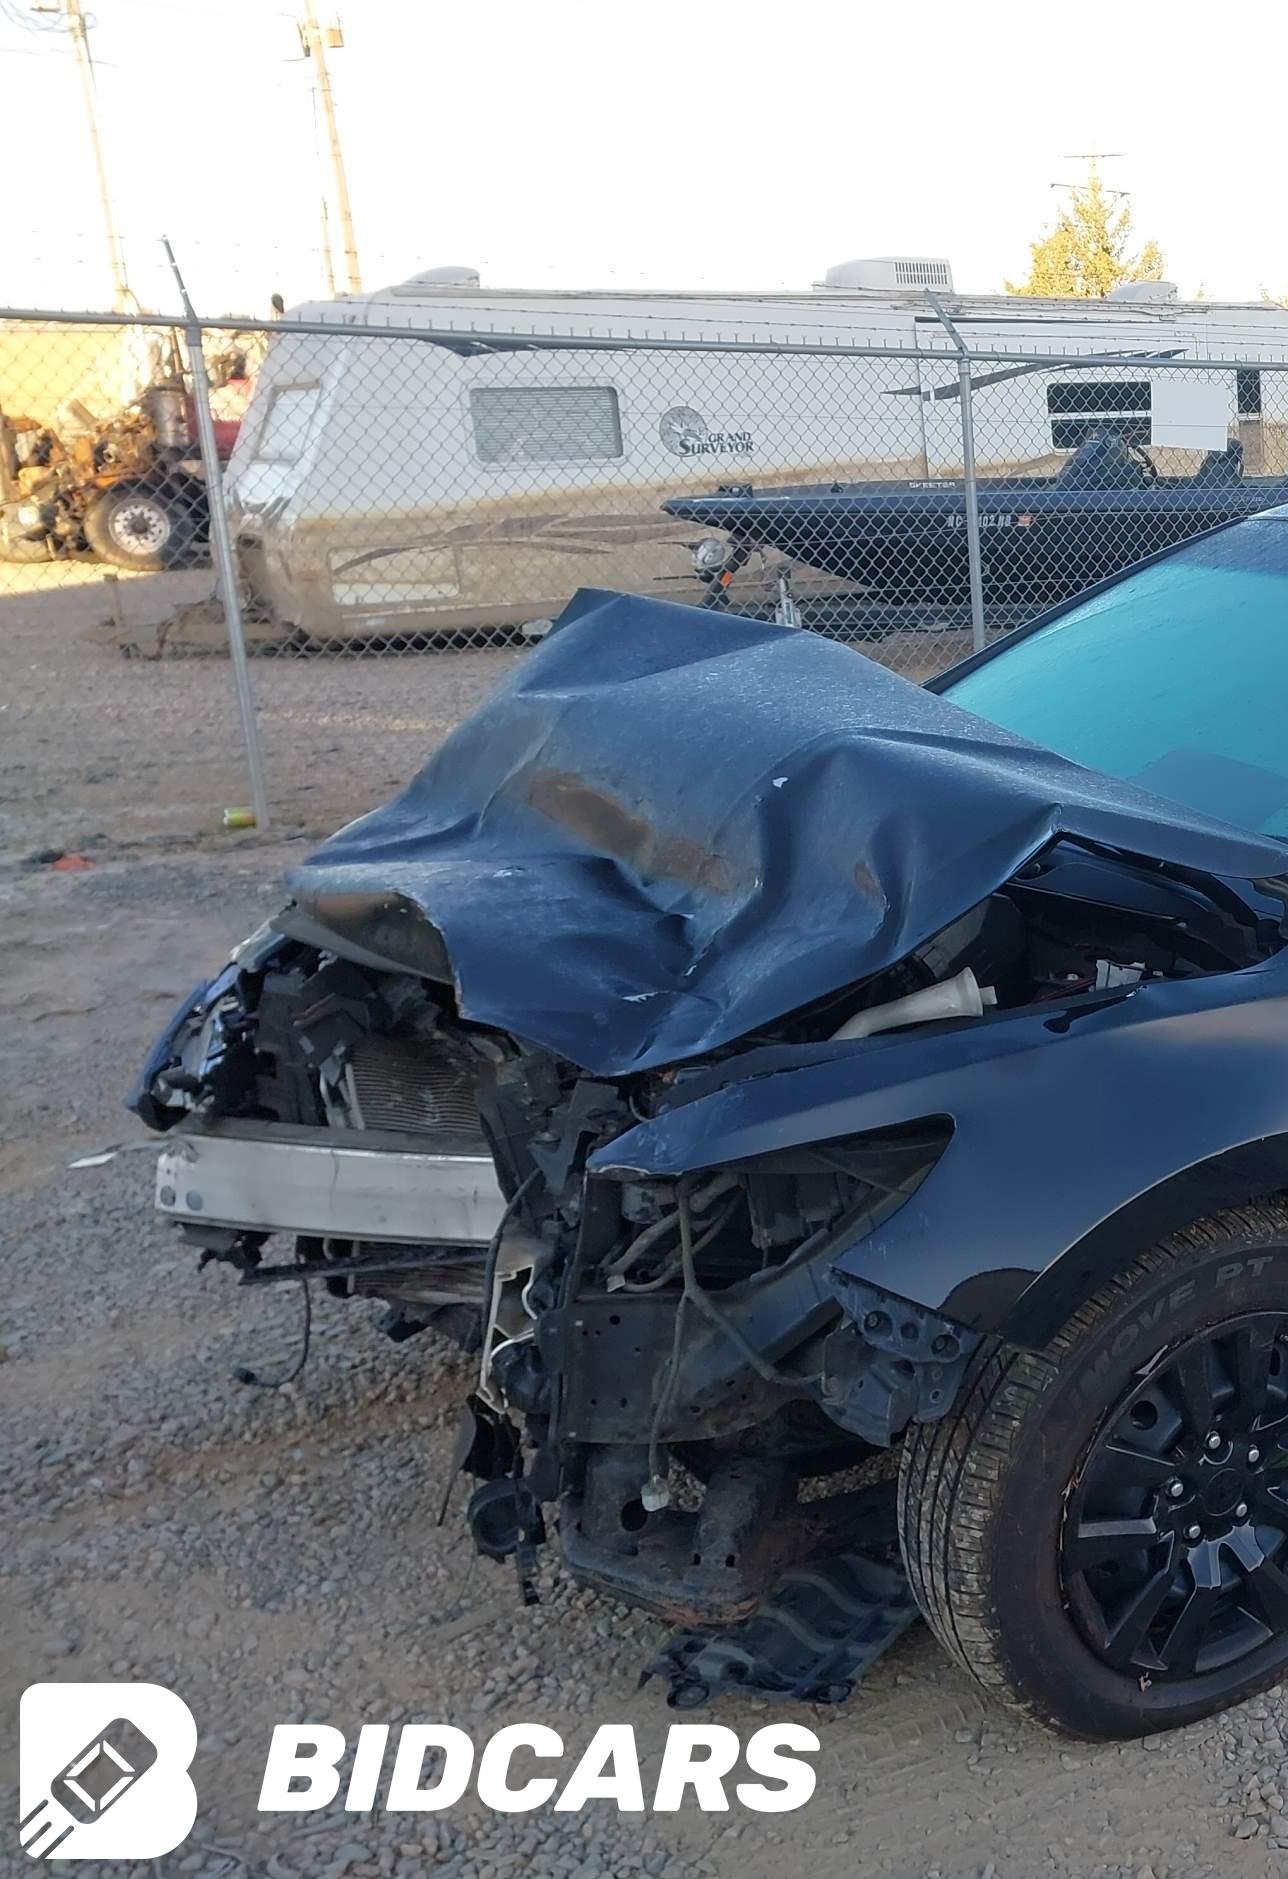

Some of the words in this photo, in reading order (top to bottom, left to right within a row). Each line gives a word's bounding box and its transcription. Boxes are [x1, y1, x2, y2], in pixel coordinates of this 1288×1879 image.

[708, 432, 752, 443] GRAND
[679, 439, 754, 455] SURVEYOR
[1215, 1256, 1273, 1289] PT
